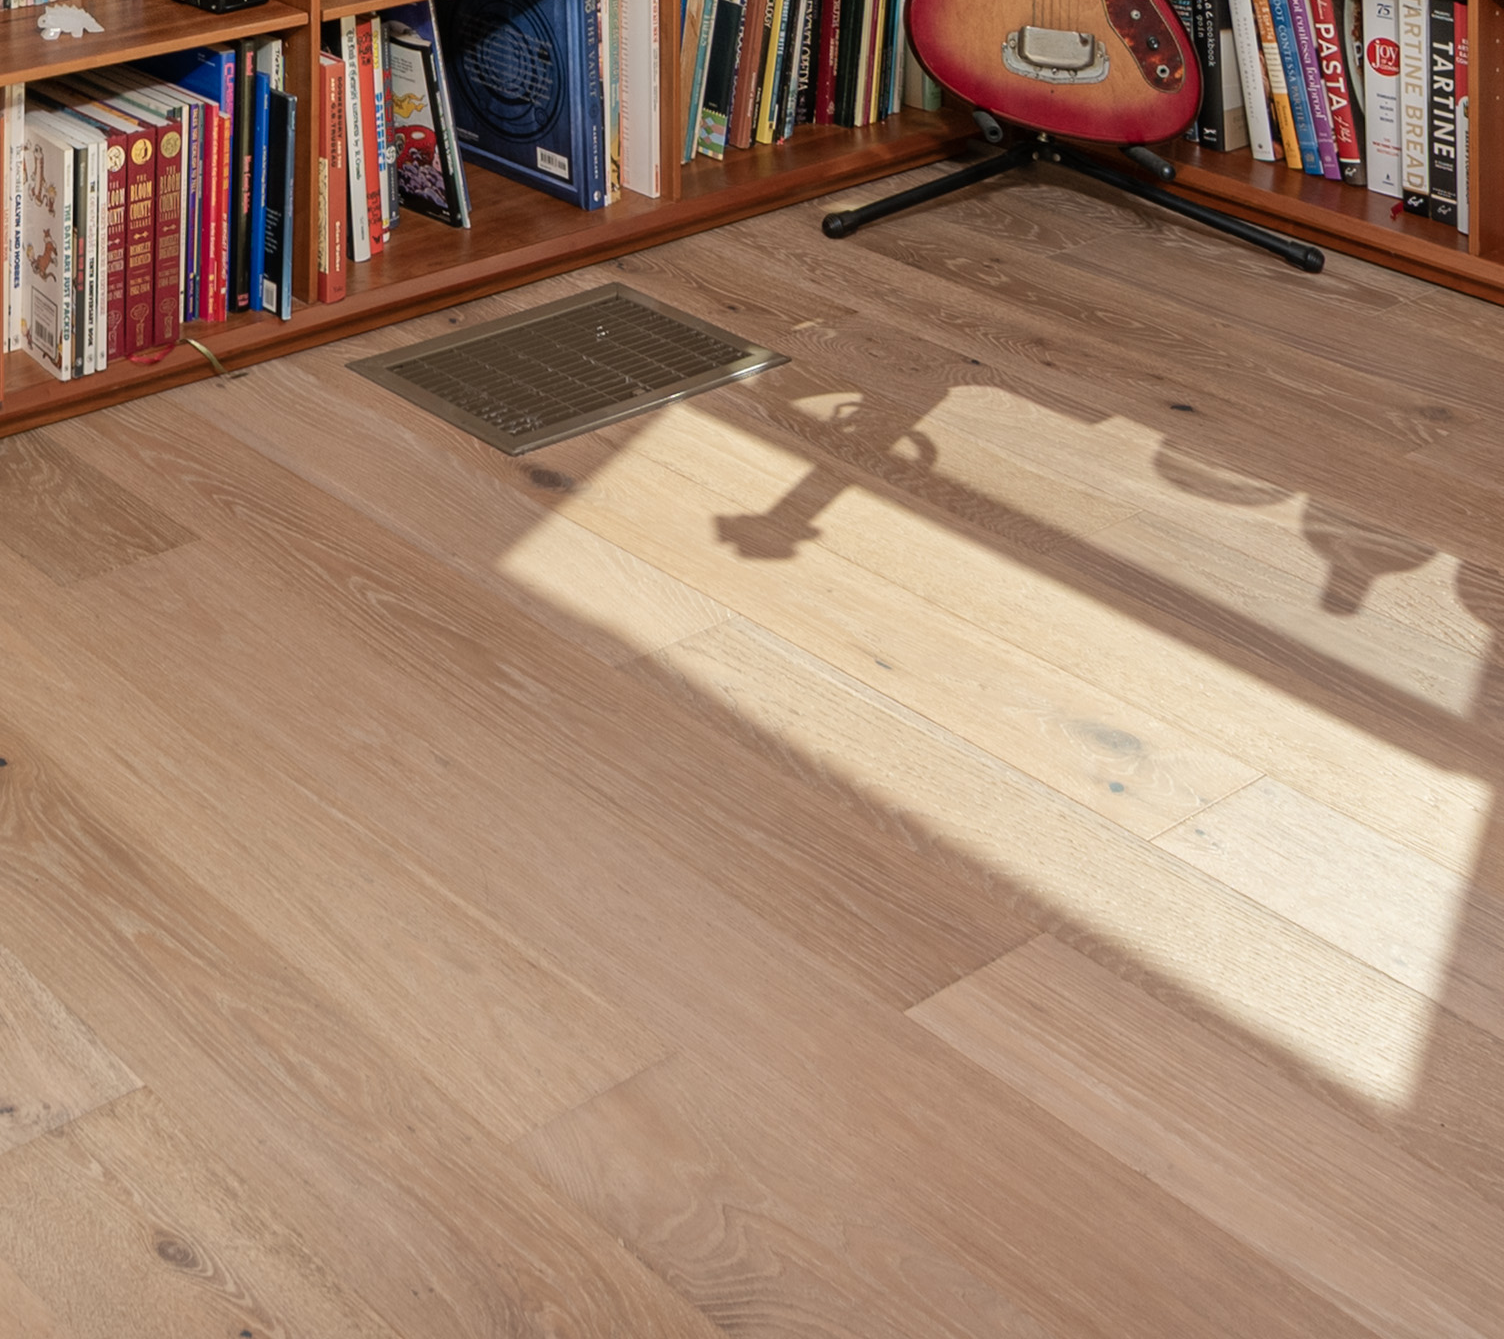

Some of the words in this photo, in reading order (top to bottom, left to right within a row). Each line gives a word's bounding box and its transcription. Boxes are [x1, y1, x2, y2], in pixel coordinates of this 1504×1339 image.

[1376, 2, 1393, 16] 75
[587, 15, 596, 47] THE
[1196, 14, 1205, 38] goin
[1295, 16, 1314, 65] contessa
[1205, 20, 1216, 68] cookbook
[1371, 38, 1399, 69] joy
[588, 51, 598, 98] VAULT
[1276, 23, 1297, 83] CONTESSA
[1289, 85, 1308, 133] PARTIES!
[1314, 22, 1347, 111] PASTA
[1304, 66, 1326, 121] foolproof
[1432, 41, 1455, 160] TARTINE
[375, 92, 386, 172] PATIENCE
[1404, 104, 1426, 191] BREAD
[130, 180, 152, 201] BLOOM
[14, 194, 23, 228] CALVIN
[63, 203, 72, 223] THE
[129, 202, 152, 221] COUNTY
[14, 229, 22, 249] AND
[63, 225, 72, 253] DAYS
[13, 250, 22, 289] HOBBES
[63, 254, 72, 274] ARE
[63, 275, 72, 298] JUST
[62, 301, 71, 342] PACKED
[86, 326, 94, 348] BOOK
